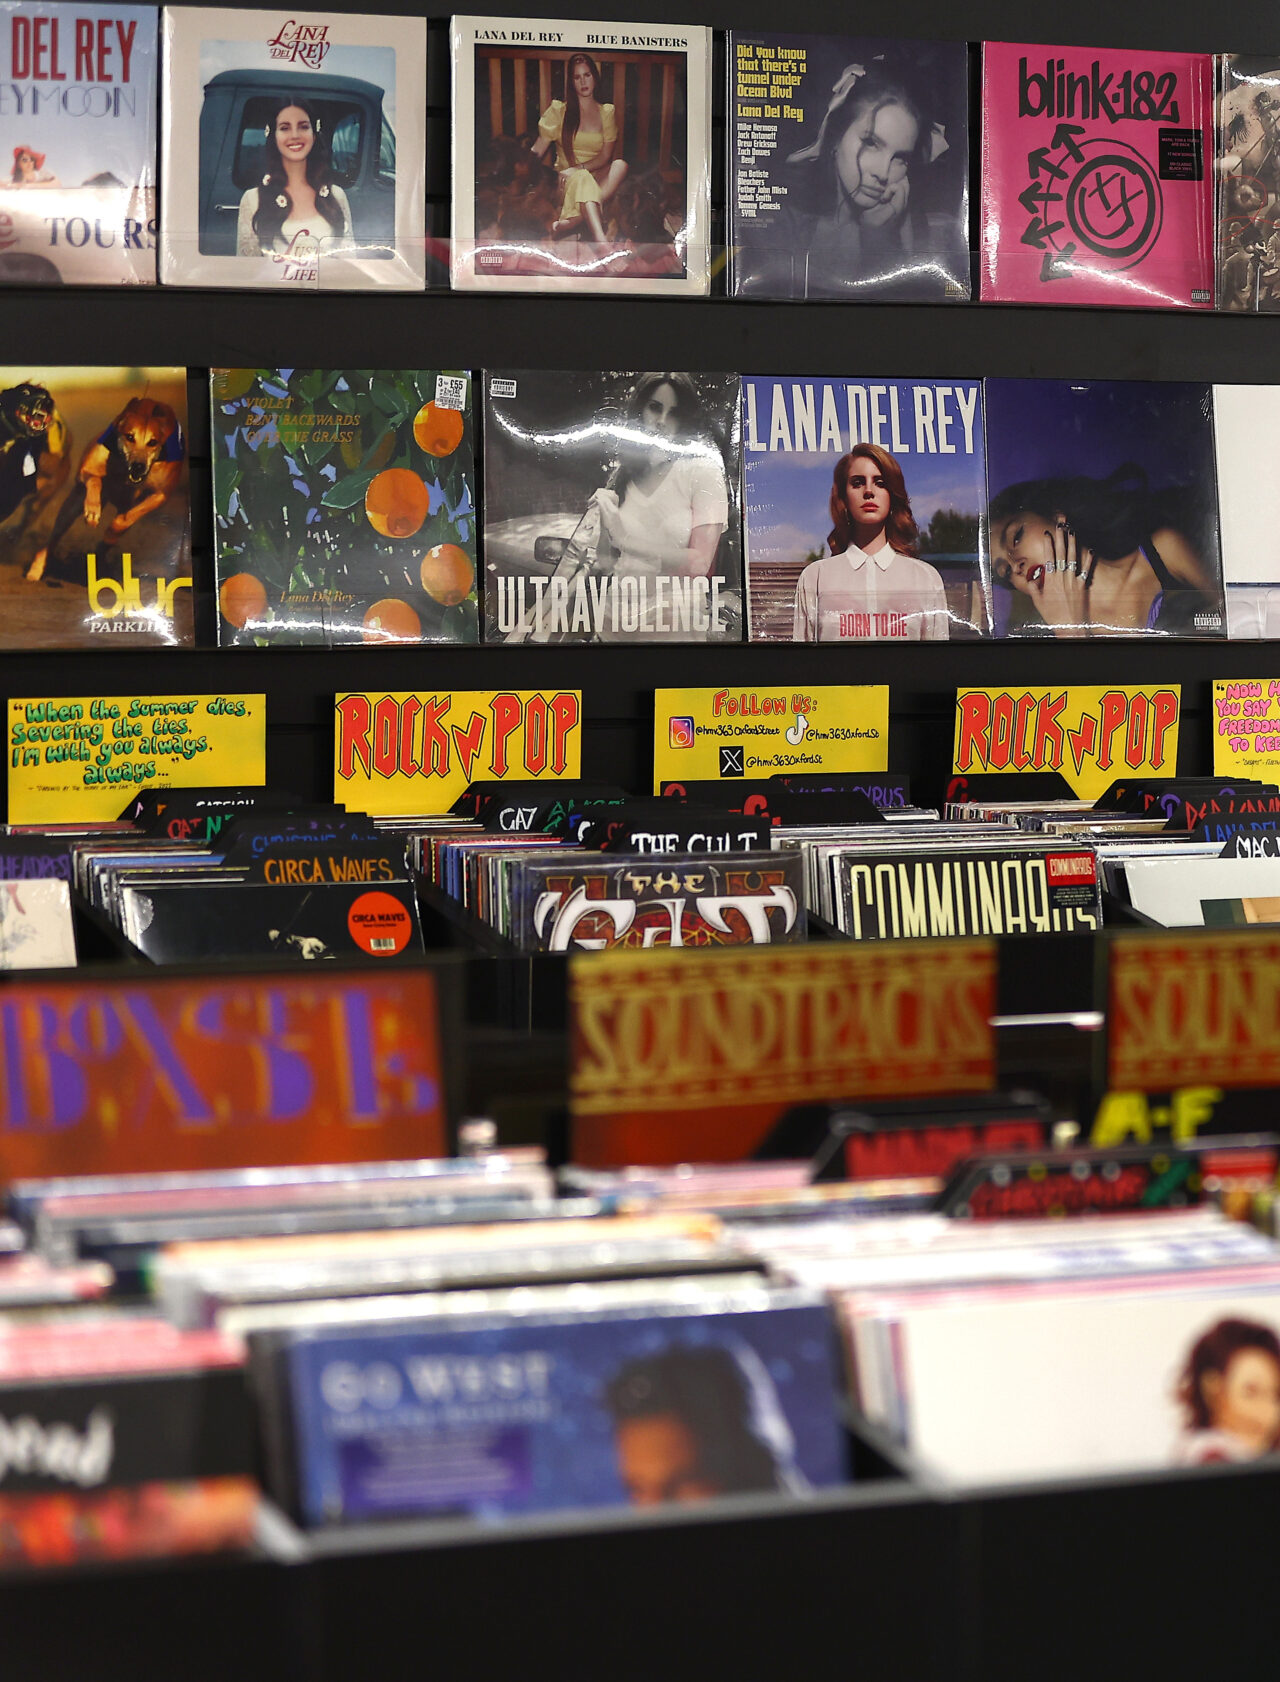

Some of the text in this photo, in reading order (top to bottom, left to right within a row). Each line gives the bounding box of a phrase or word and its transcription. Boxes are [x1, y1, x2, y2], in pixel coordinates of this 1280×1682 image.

[12, 16, 137, 83] DEL REY
[474, 30, 688, 48] LANA DEL REY BLUE BANISTERS
[290, 41, 330, 69] REY
[737, 45, 806, 60] Did you know
[737, 58, 807, 73] that there's a
[737, 71, 801, 86] tunnel under
[737, 84, 793, 98] Ocean Blvd
[1018, 57, 1181, 124] blink-182
[737, 104, 804, 122] Lana Del Rey
[280, 264, 318, 281] LIFE
[282, 414, 361, 426] BACKWARDS
[747, 383, 978, 454] LANA DEL REY
[312, 431, 354, 443] GRASS
[87, 553, 193, 619] blur
[497, 576, 726, 633] ULTRAVIOLENCE
[89, 621, 175, 633] PARKLIE
[840, 612, 908, 637] BORN TO DIE
[90, 700, 120, 720] the
[128, 700, 198, 718] Summer
[1215, 698, 1241, 718] YOU
[1243, 699, 1272, 717] SAY
[11, 722, 104, 746] Severing
[112, 718, 144, 739] the
[335, 693, 451, 780] ROCK
[489, 693, 579, 779] POP
[955, 690, 1068, 773] ROCK
[1096, 690, 1178, 772] POP
[12, 745, 40, 767] I'm
[96, 739, 135, 766] you
[1229, 737, 1250, 752] TO
[631, 833, 679, 852] THE
[1236, 835, 1275, 858] MAC
[264, 856, 394, 884] CIRCA WAVES
[320, 1351, 554, 1412] GO WEST
